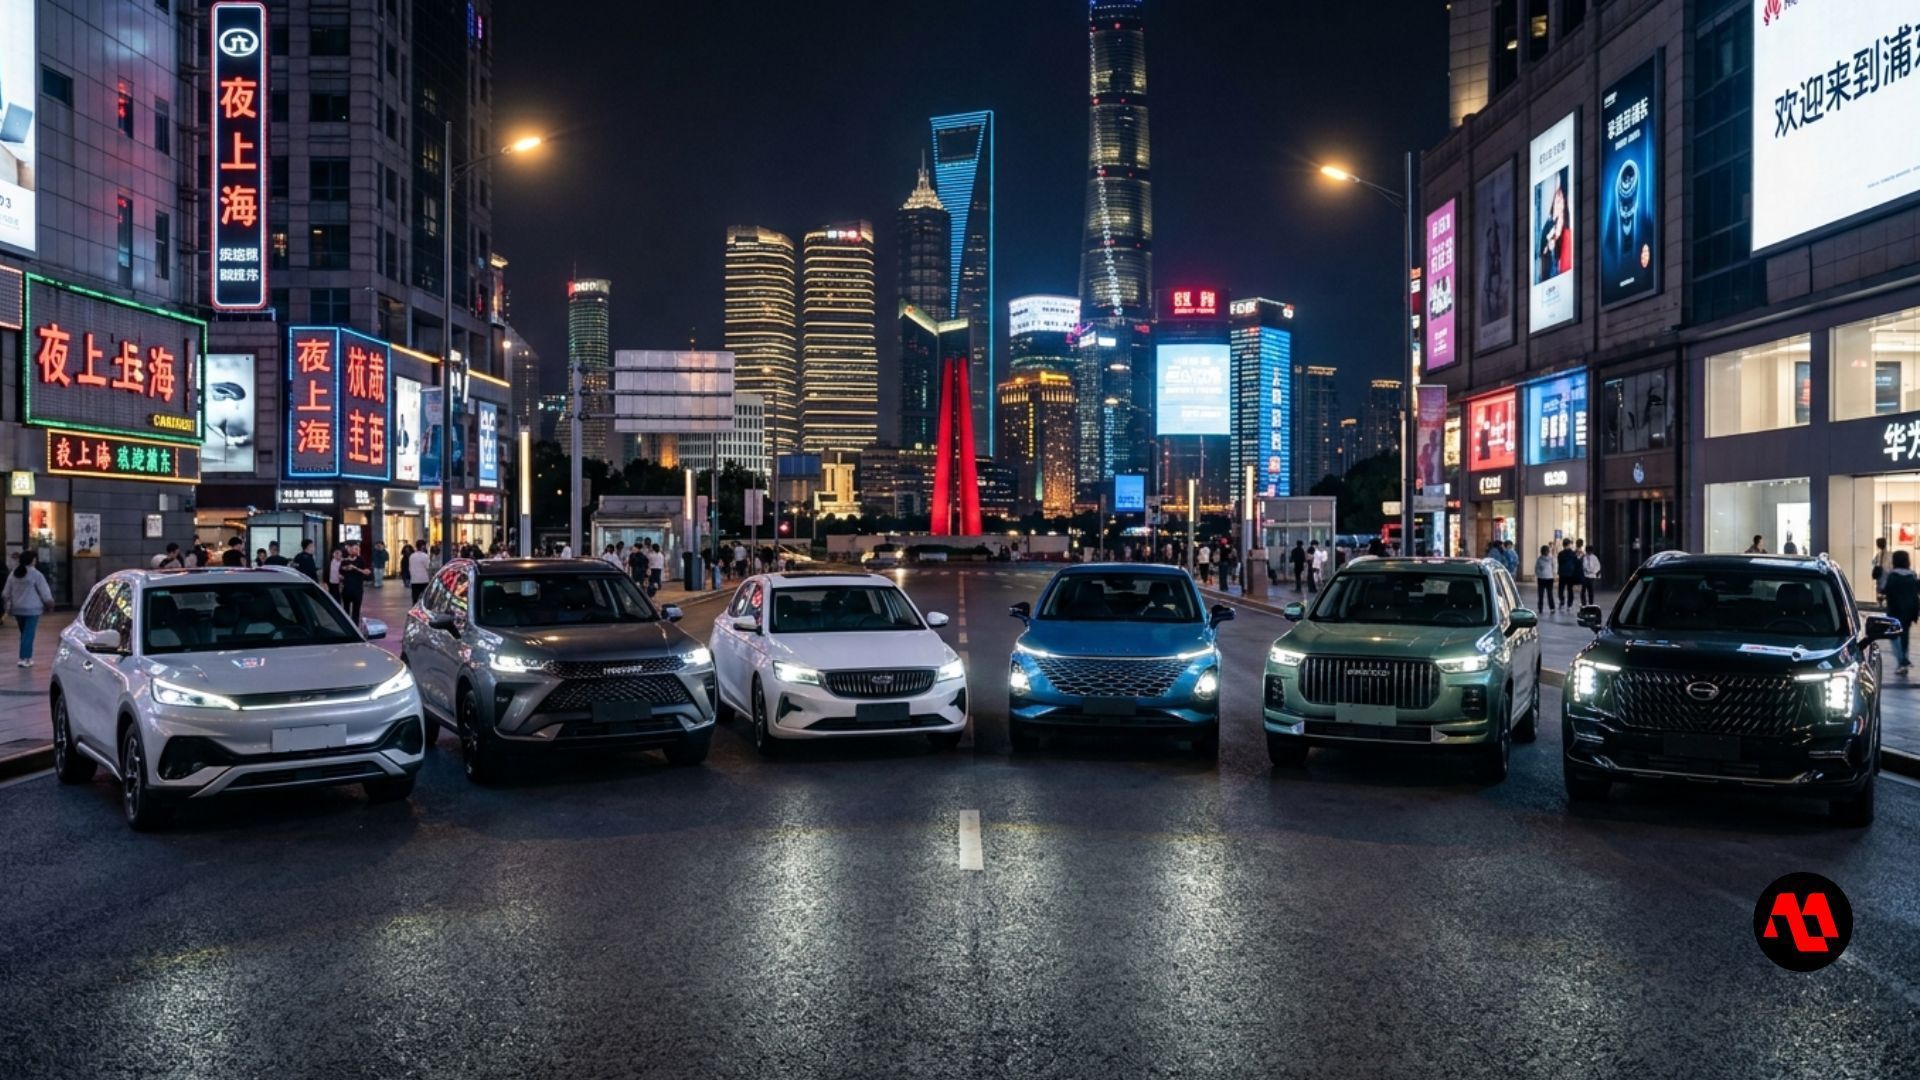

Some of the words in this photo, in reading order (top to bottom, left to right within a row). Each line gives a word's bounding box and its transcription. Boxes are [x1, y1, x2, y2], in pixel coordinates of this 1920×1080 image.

[1775, 23, 1920, 138] 欢迎来到浦
[220, 77, 257, 227] 夜上海
[296, 338, 331, 454] 夜上海
